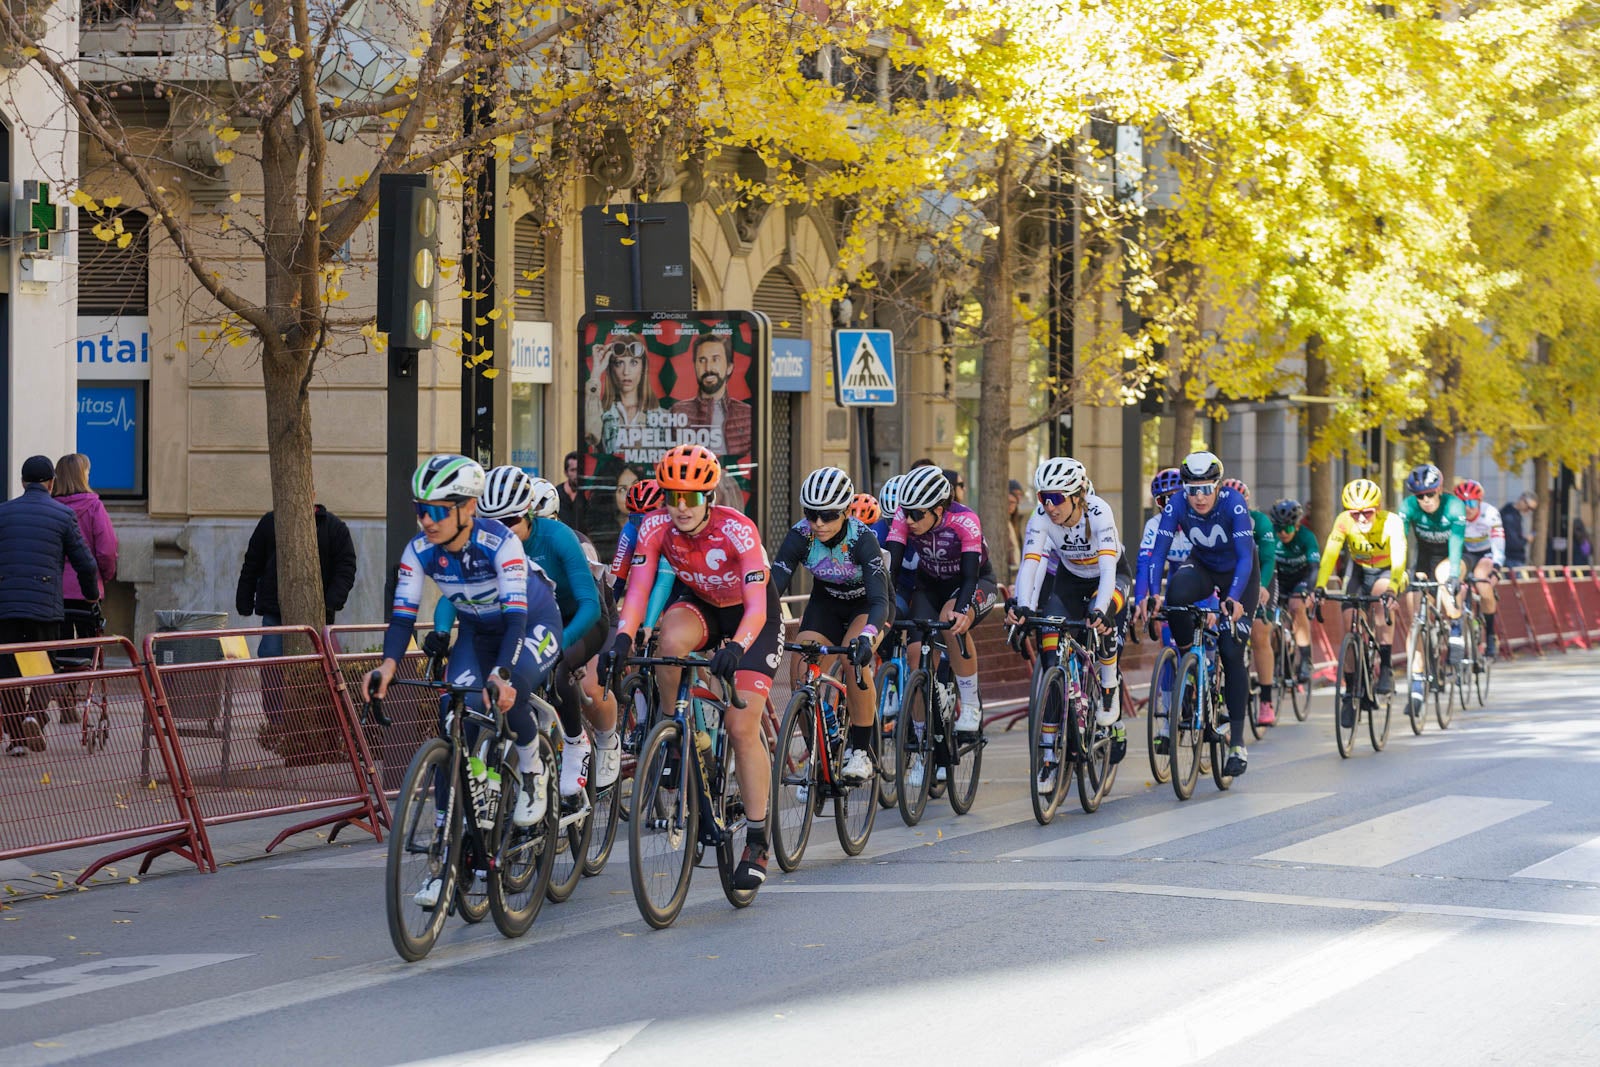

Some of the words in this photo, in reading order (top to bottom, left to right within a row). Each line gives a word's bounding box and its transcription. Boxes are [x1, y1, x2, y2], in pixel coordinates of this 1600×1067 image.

[651, 312, 688, 320] JCDecaux
[77, 332, 148, 363] ntal
[649, 413, 688, 427] OCHO
[616, 427, 722, 447] APELLIDOS
